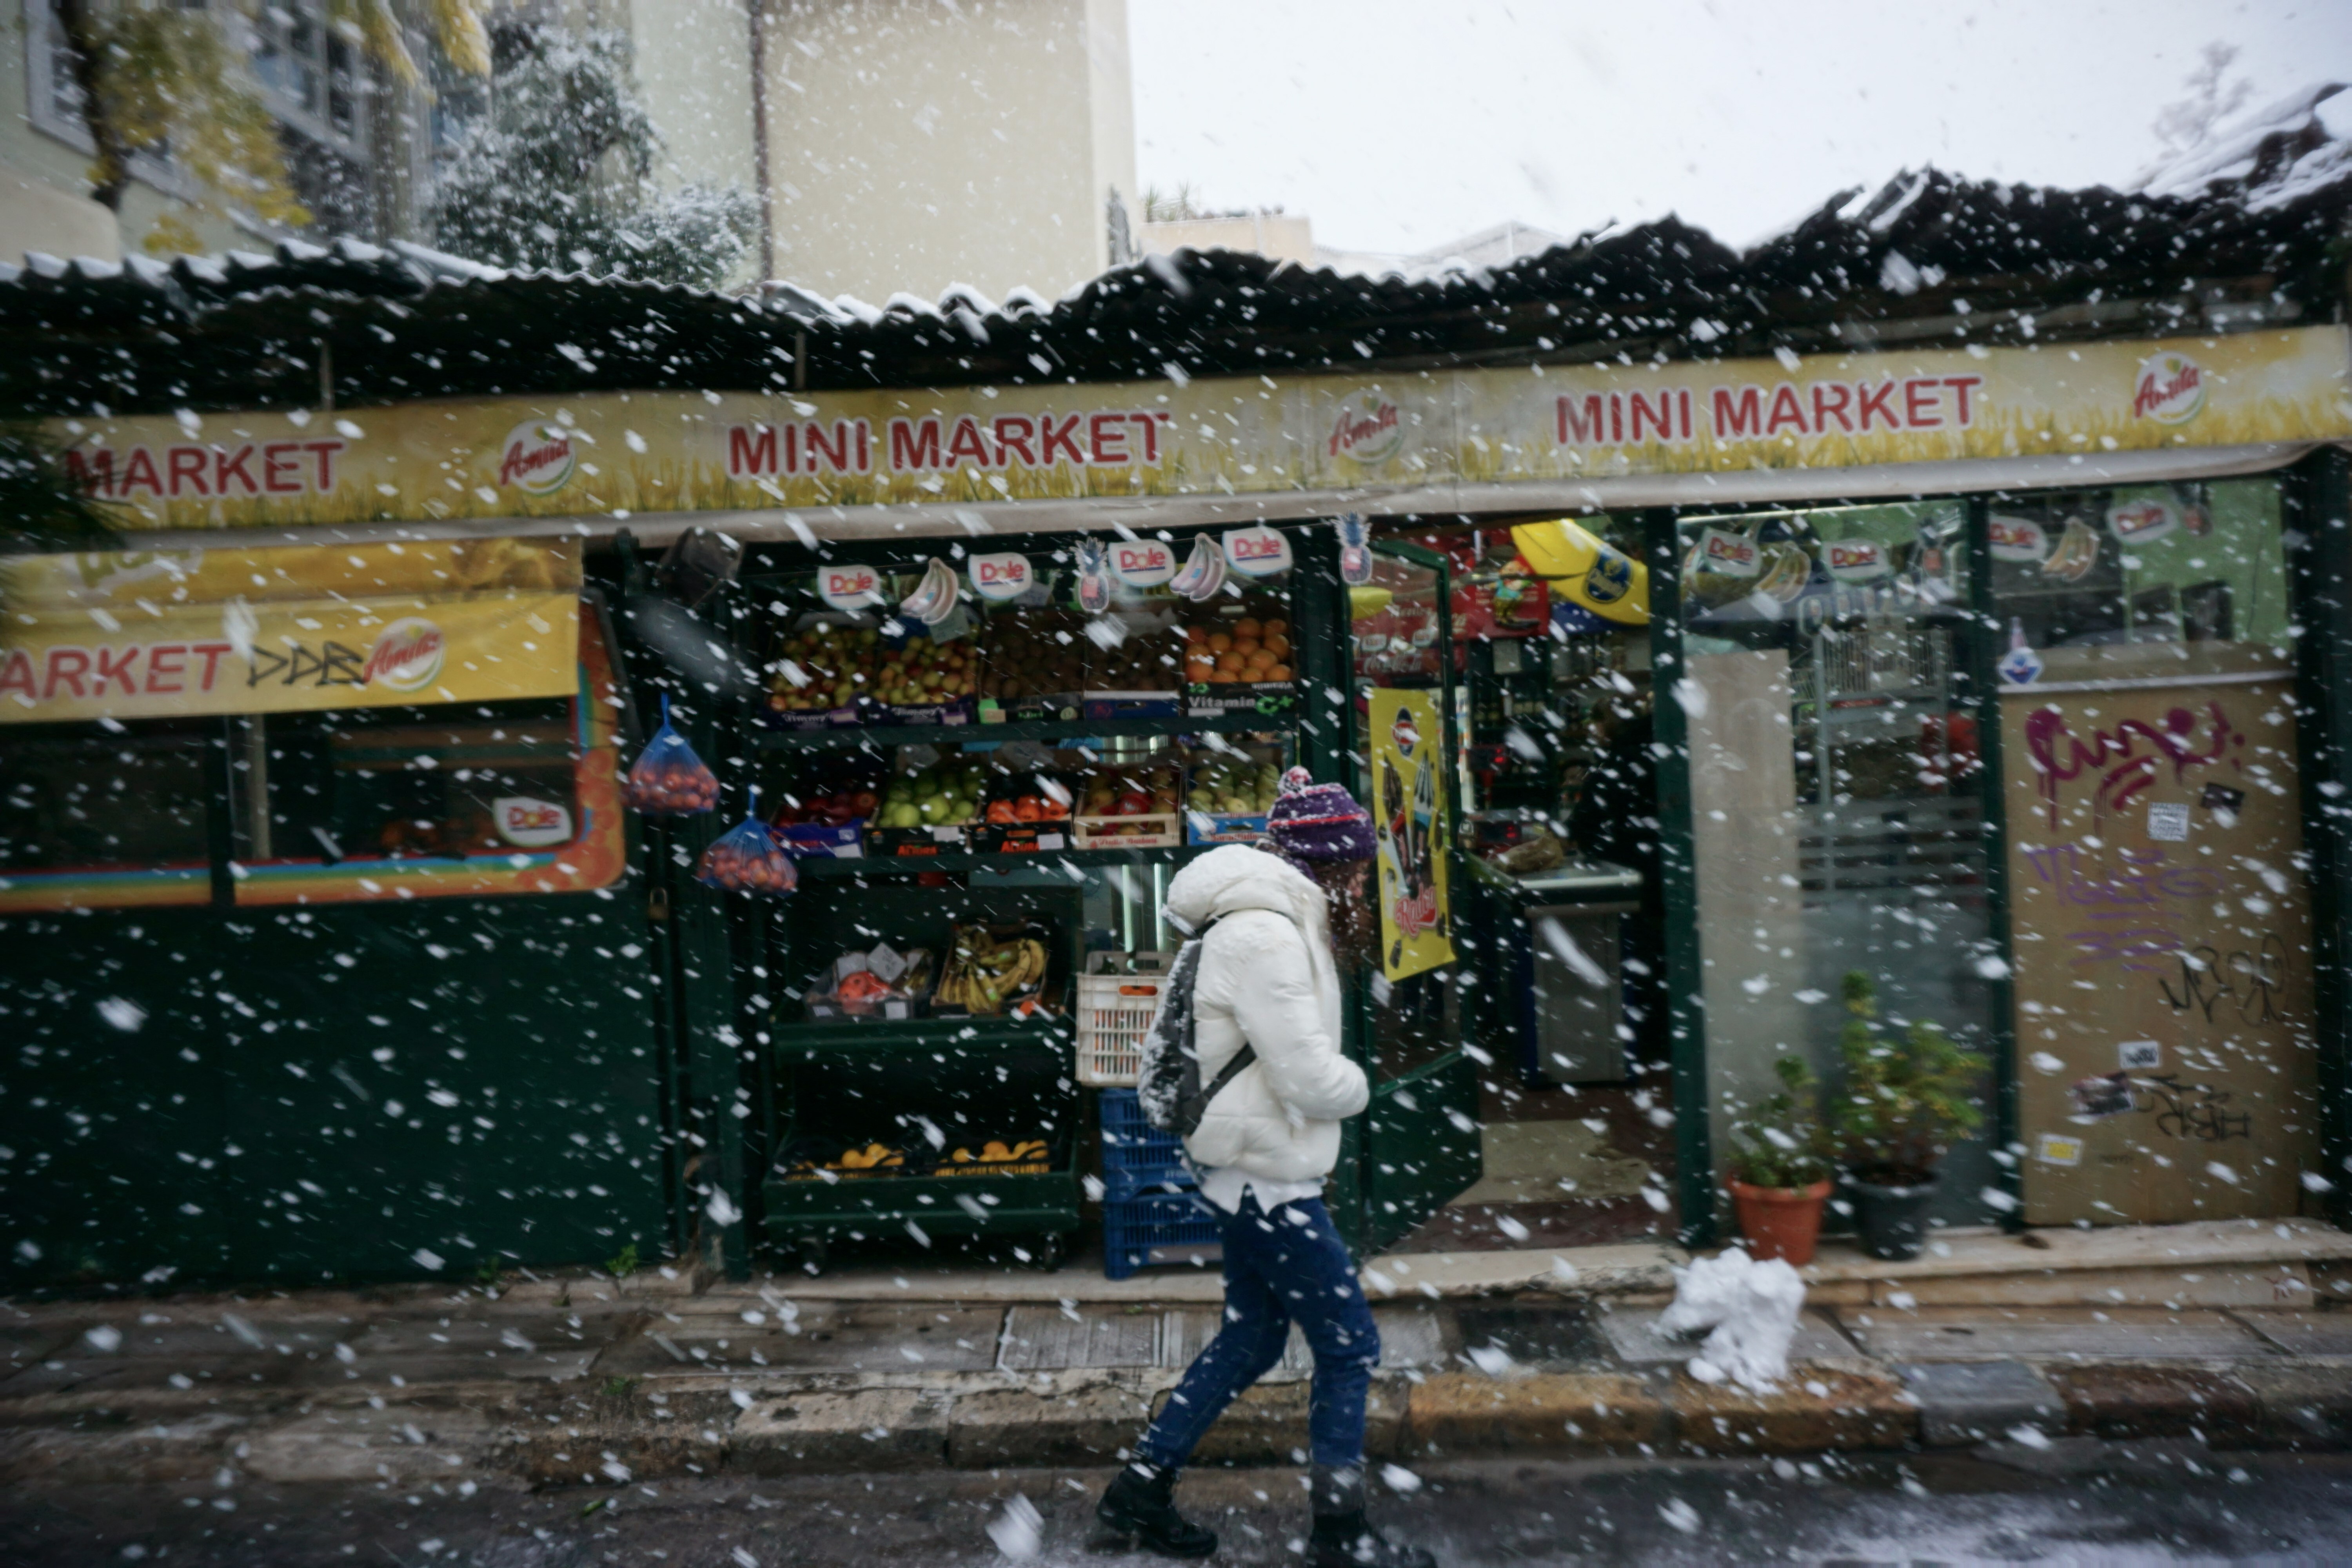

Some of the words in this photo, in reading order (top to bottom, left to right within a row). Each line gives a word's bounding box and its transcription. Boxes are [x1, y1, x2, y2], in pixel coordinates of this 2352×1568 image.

[2134, 362, 2200, 420] Amita
[1328, 401, 1399, 458] Amita
[1556, 388, 1693, 445] MINI
[1713, 376, 1982, 437] MARKET
[499, 435, 576, 486] Amita
[729, 420, 870, 475] MINI
[892, 412, 1171, 471] MARKET
[67, 440, 345, 498] MARKET
[1119, 547, 1167, 571] Dole
[1233, 536, 1281, 558] Dole
[1708, 536, 1753, 562] Dole
[829, 573, 873, 597] Dole
[980, 561, 1025, 583] Dole
[363, 631, 441, 685] Amita
[1188, 696, 1255, 708] Vitamin
[1255, 695, 1295, 714] C+
[507, 805, 561, 827] Dole
